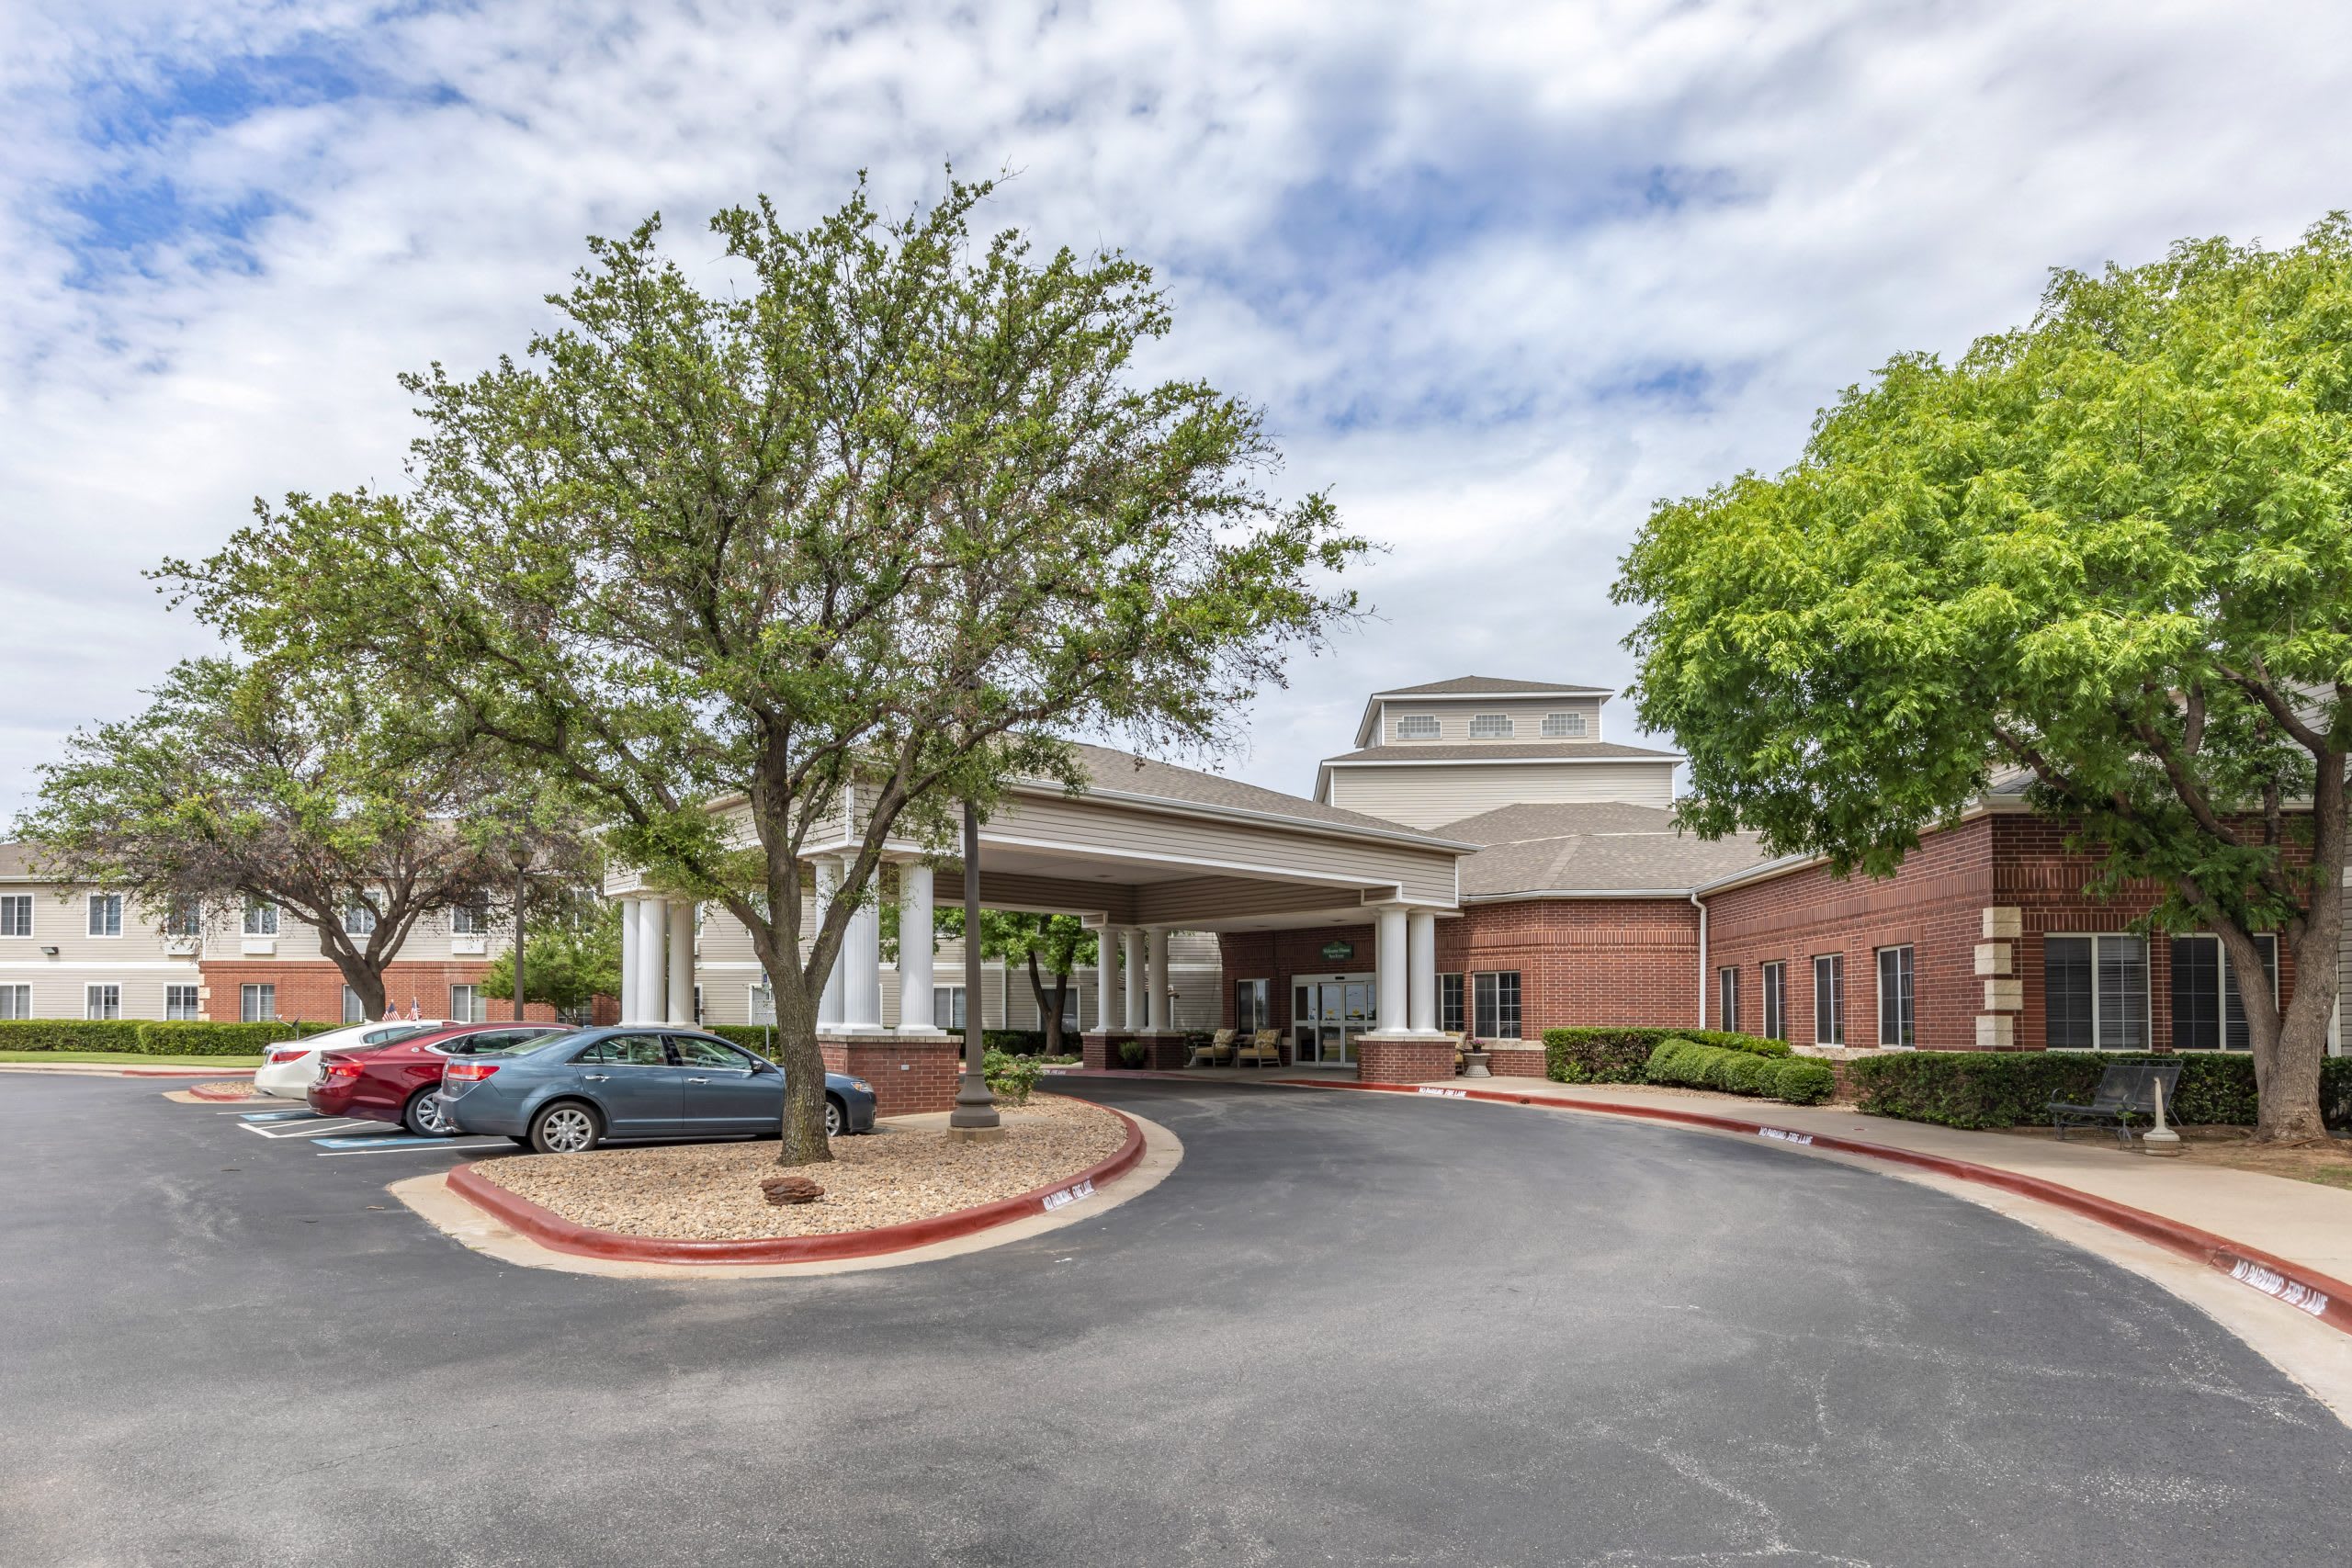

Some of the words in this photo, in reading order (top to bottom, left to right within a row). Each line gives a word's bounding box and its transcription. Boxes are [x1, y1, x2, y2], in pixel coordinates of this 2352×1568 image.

[1758, 1126, 1768, 1137] NO
[1785, 1132, 1800, 1143] FIRE
[1797, 1134, 1814, 1146] LANE
[2229, 1259, 2249, 1281] NO
[2245, 1264, 2285, 1295] PARKING
[2278, 1280, 2307, 1305] FIRE
[2297, 1288, 2329, 1316] LANE
